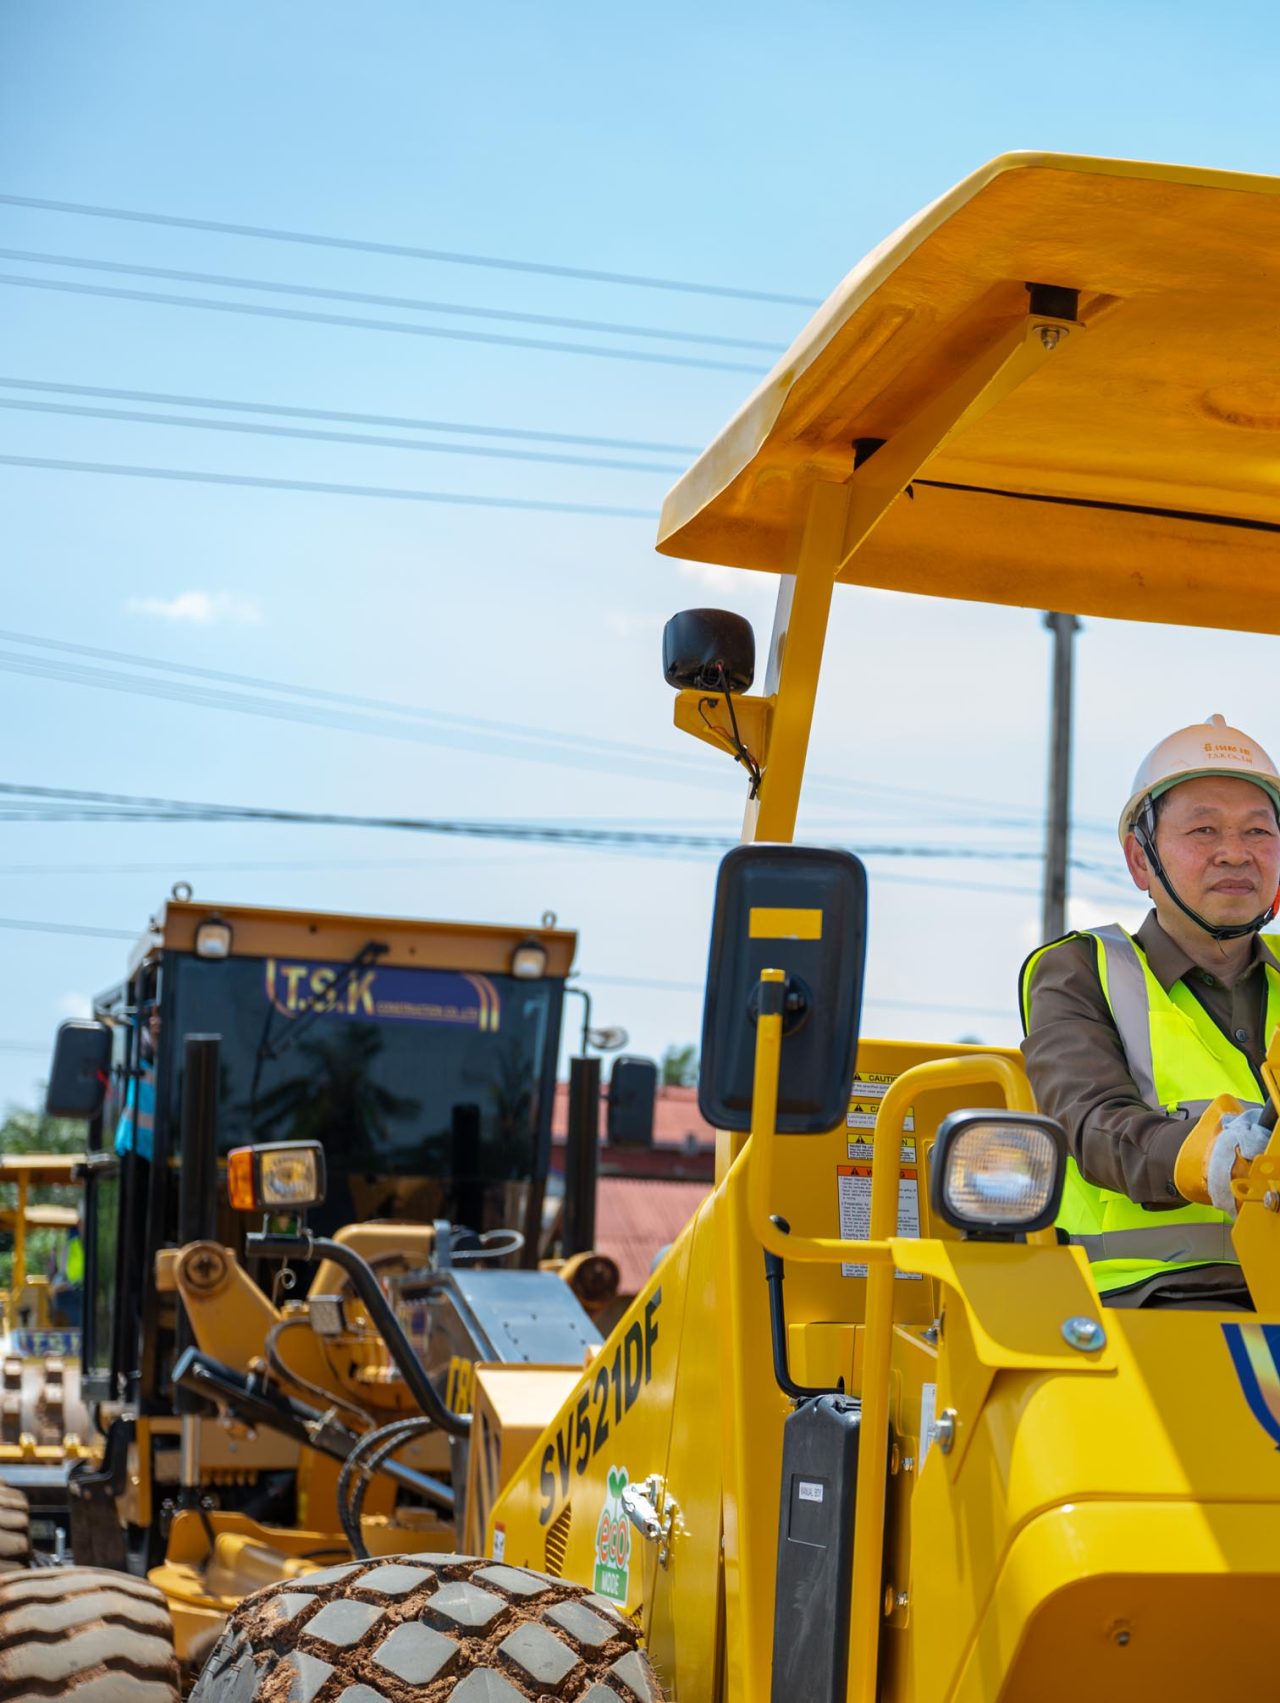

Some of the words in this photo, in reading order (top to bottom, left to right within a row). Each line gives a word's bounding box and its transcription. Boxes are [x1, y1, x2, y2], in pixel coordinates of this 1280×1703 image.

[539, 1285, 662, 1526] SV521DF
[599, 1514, 627, 1567] eco
[601, 1570, 621, 1596] MODE
